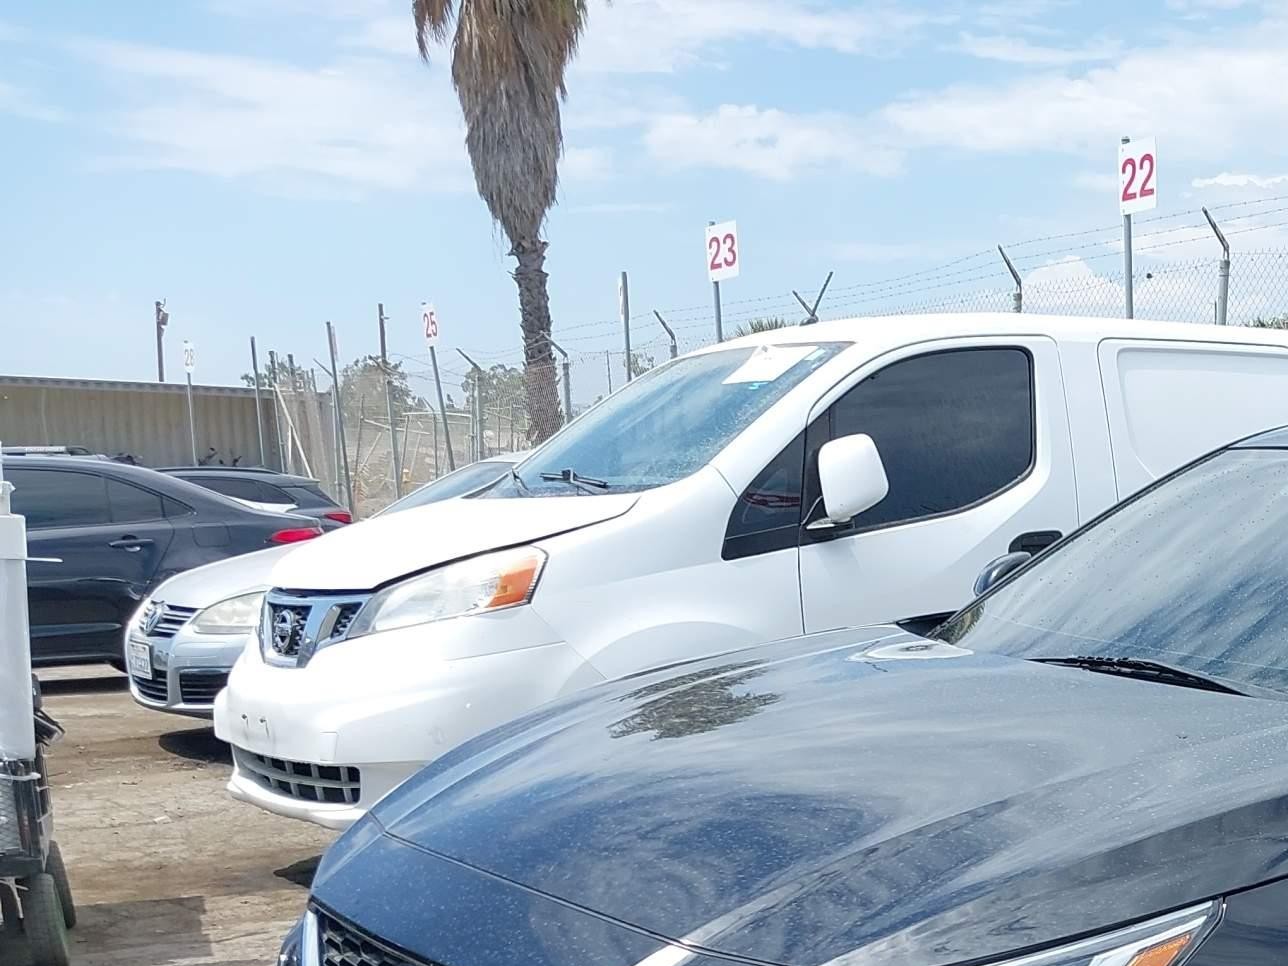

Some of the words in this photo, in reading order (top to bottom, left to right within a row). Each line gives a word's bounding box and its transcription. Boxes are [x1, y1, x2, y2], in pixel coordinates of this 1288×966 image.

[1121, 153, 1155, 202] 22
[708, 232, 737, 271] 23
[422, 311, 438, 338] 25
